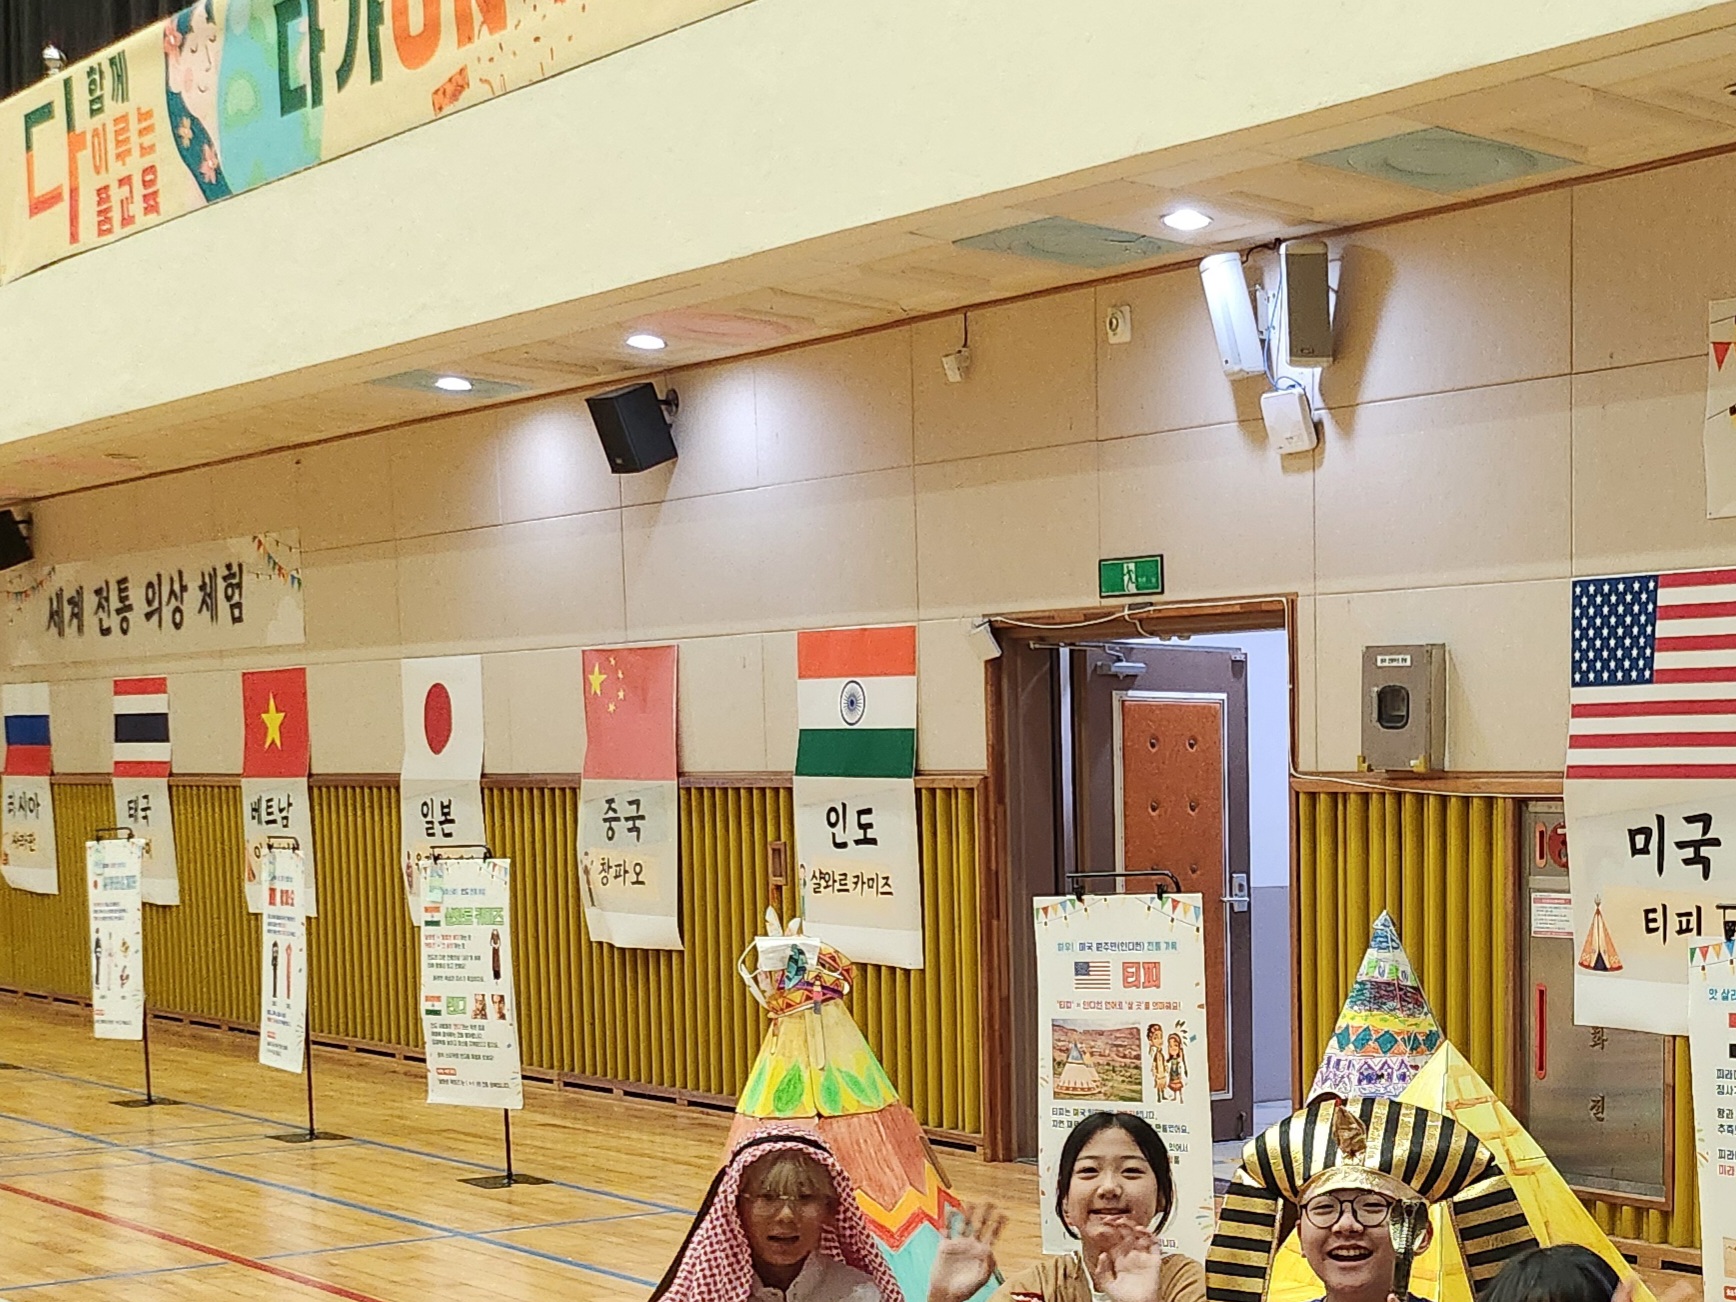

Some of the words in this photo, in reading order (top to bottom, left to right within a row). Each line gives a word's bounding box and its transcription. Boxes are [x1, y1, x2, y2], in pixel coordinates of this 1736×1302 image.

[87, 50, 129, 119] 함께
[24, 76, 87, 246] 다
[92, 106, 156, 175] 이루는
[47, 586, 85, 638] 세계
[94, 577, 134, 636] 전통
[144, 569, 188, 631] 의상
[198, 562, 244, 625] 체험
[127, 794, 152, 827] 태국
[250, 793, 293, 829] 베트남
[421, 798, 456, 838] 일본
[602, 798, 646, 842] 중국
[826, 802, 879, 850] 인도
[1627, 813, 1722, 881] 미국
[599, 857, 646, 887] 창파오
[811, 869, 850, 895] 샬와르
[851, 871, 894, 897] 카미즈
[1643, 904, 1702, 946] 티피
[1079, 941, 1094, 952] 미국
[1147, 941, 1161, 952] 전통
[1121, 961, 1161, 989] 티피
